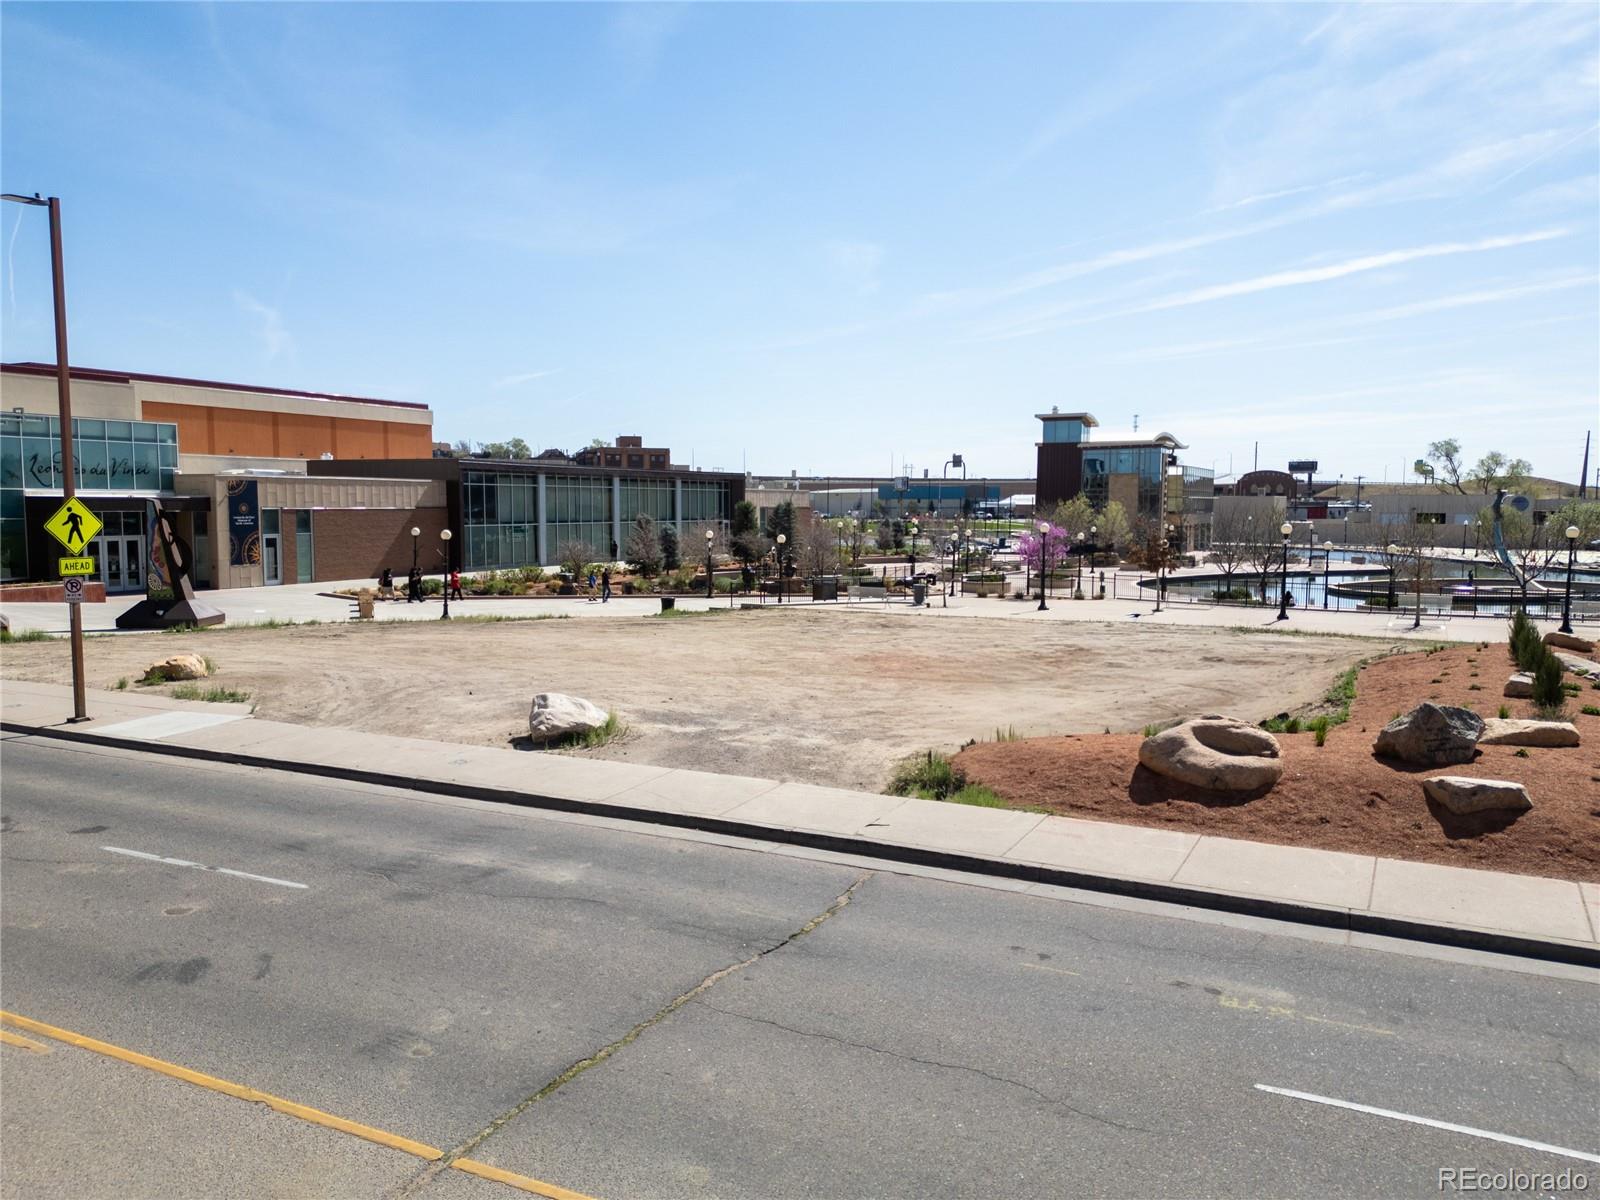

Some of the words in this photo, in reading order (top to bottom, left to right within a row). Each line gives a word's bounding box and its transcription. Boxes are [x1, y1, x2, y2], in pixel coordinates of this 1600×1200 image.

[30, 451, 86, 488] Leondo
[90, 463, 107, 476] da
[112, 457, 150, 477] Vinci
[64, 561, 90, 571] AHEAD
